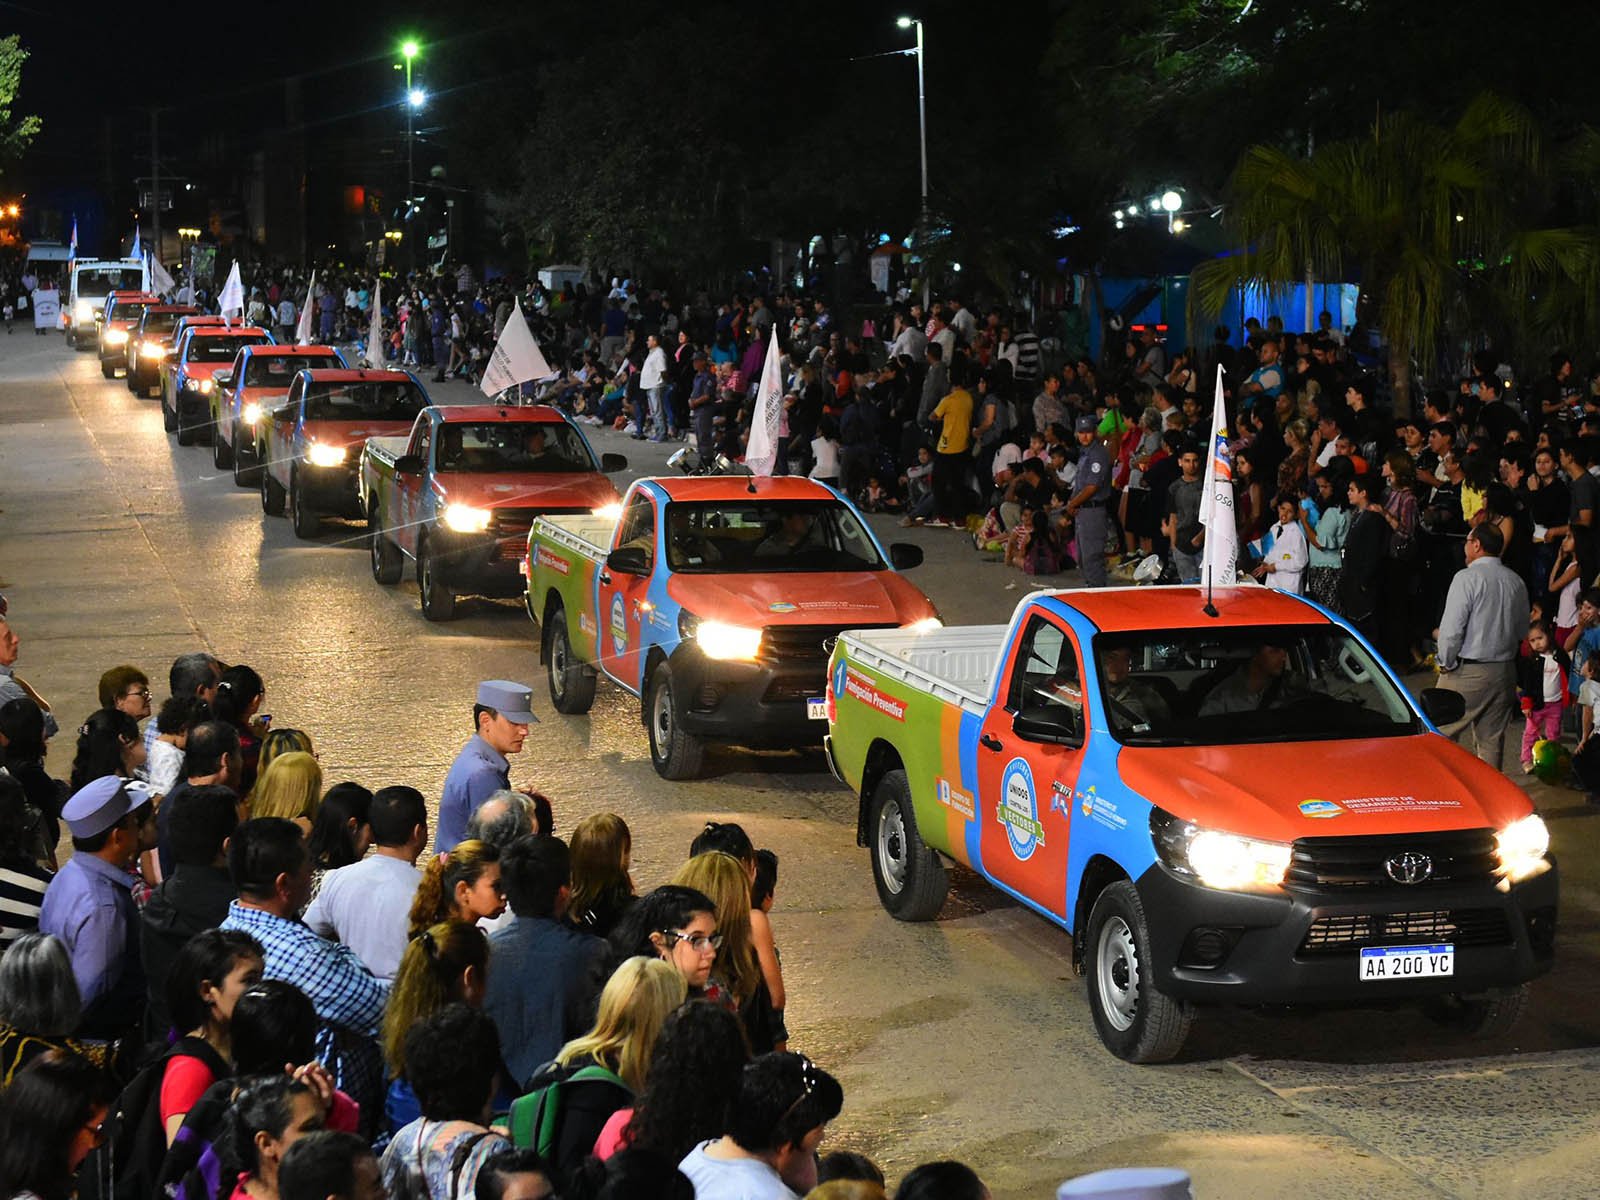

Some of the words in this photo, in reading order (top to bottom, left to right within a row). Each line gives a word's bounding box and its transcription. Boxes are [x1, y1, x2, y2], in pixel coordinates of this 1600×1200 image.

[836, 663, 844, 695] 1
[845, 675, 874, 704] Fumigación
[872, 691, 903, 719] Preventiva
[1008, 782, 1029, 801] UNIDOS
[1342, 796, 1399, 804] MINISTERIO
[1347, 799, 1416, 809] DESARROLLO
[1004, 808, 1036, 834] VECTORES
[1366, 958, 1386, 977] AA
[1392, 956, 1424, 976] 200
[1429, 954, 1450, 973] YC
